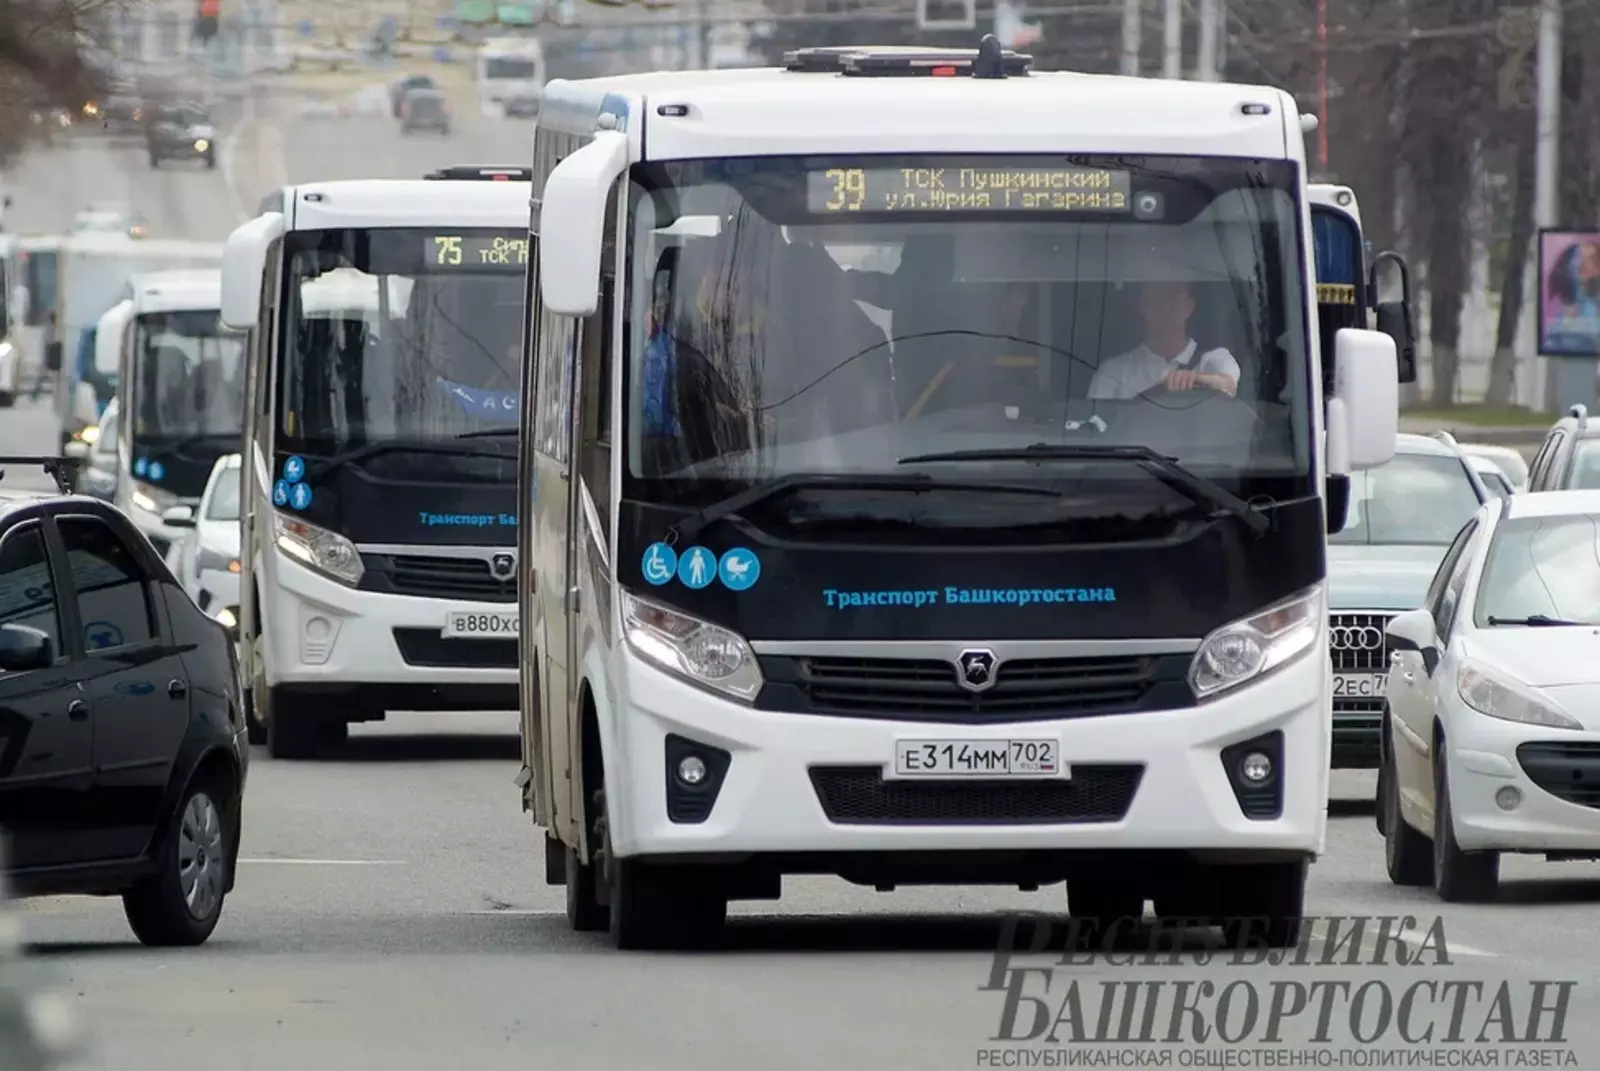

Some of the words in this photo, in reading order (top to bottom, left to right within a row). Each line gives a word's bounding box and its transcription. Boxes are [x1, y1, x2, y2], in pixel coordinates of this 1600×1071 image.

[824, 167, 866, 211] 39
[901, 168, 946, 189] ТСК
[959, 168, 1110, 190] Пушкинский
[1004, 188, 1125, 211] Гагарина
[434, 236, 463, 265] 75
[480, 249, 509, 264] ТСК
[419, 511, 496, 528] Транспорт
[823, 589, 938, 610] Транспорт
[944, 587, 1117, 606] Башкортостана
[905, 743, 1008, 770] Е314ММ
[1011, 742, 1051, 762] 702
